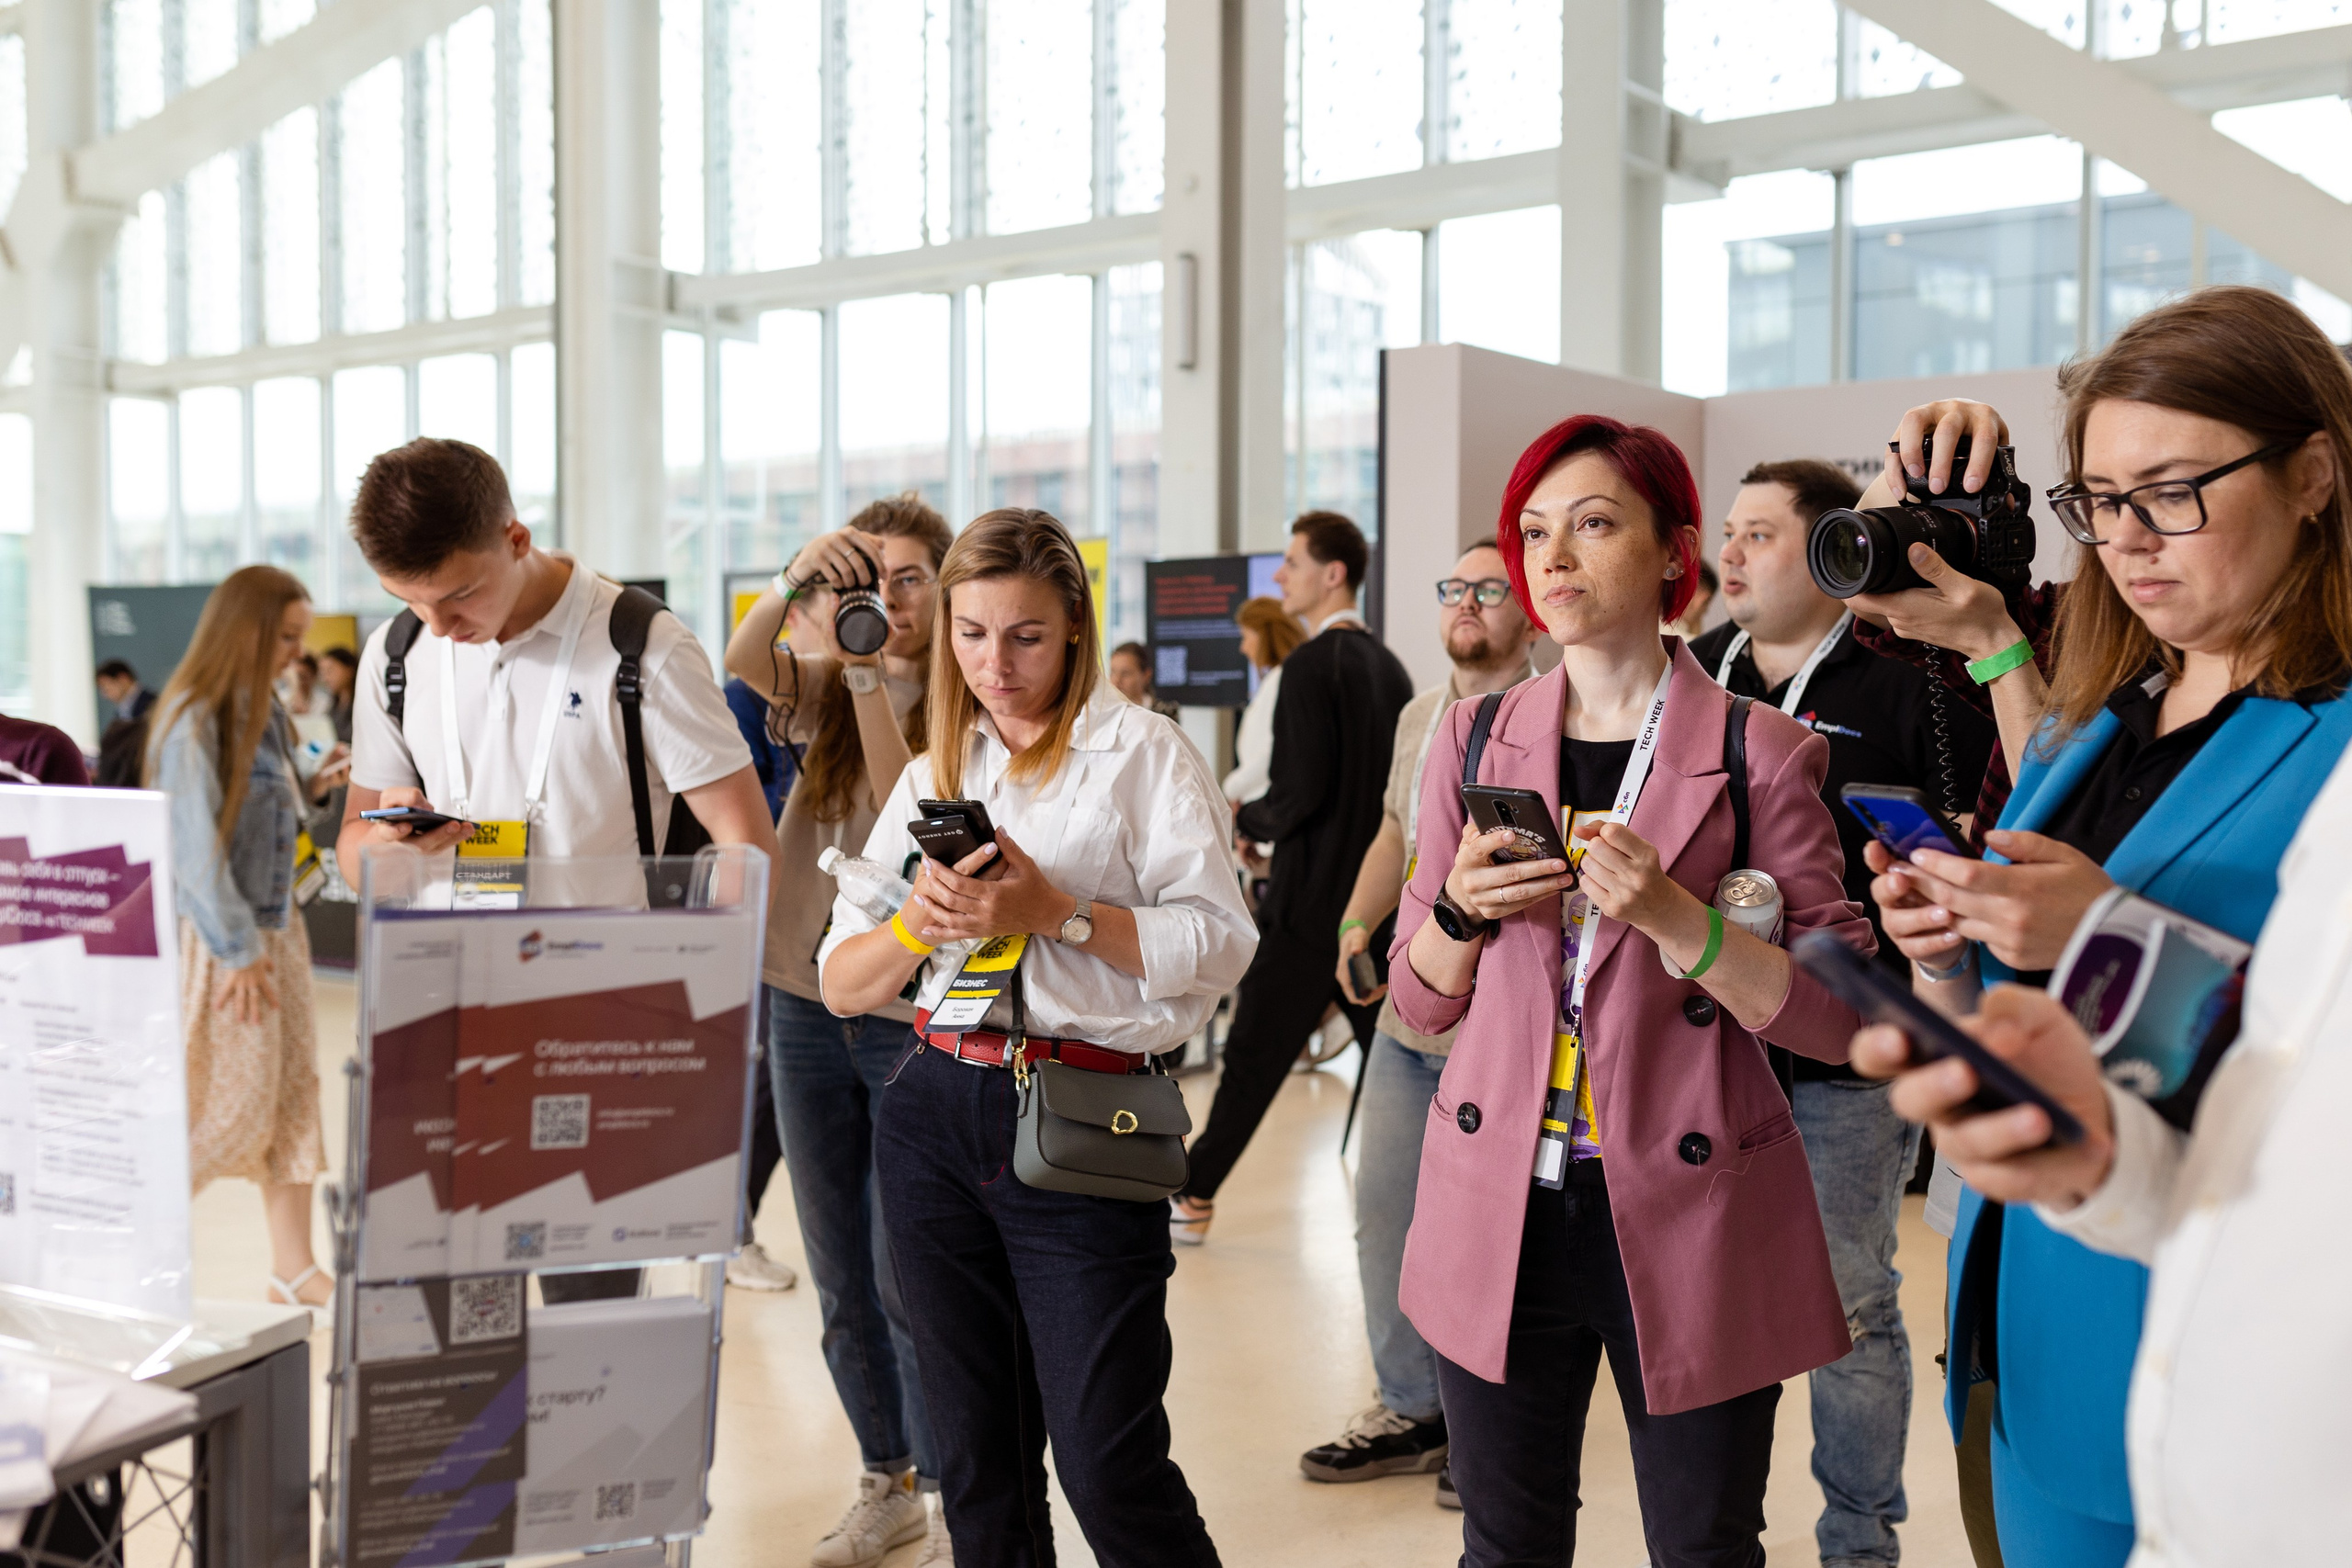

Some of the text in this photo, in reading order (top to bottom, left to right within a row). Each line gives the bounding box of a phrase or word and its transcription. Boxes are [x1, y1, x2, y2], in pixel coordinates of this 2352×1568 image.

[1639, 699, 1666, 751] TECH WEEK
[465, 836, 499, 845] WEEK
[1590, 903, 1599, 917] TE
[977, 950, 1006, 959] WEEK
[952, 978, 989, 987] БИЗНЕС
[534, 1038, 643, 1059] Обратитесь
[657, 1038, 695, 1054] нам
[533, 1056, 707, 1077] с любым вопросом
